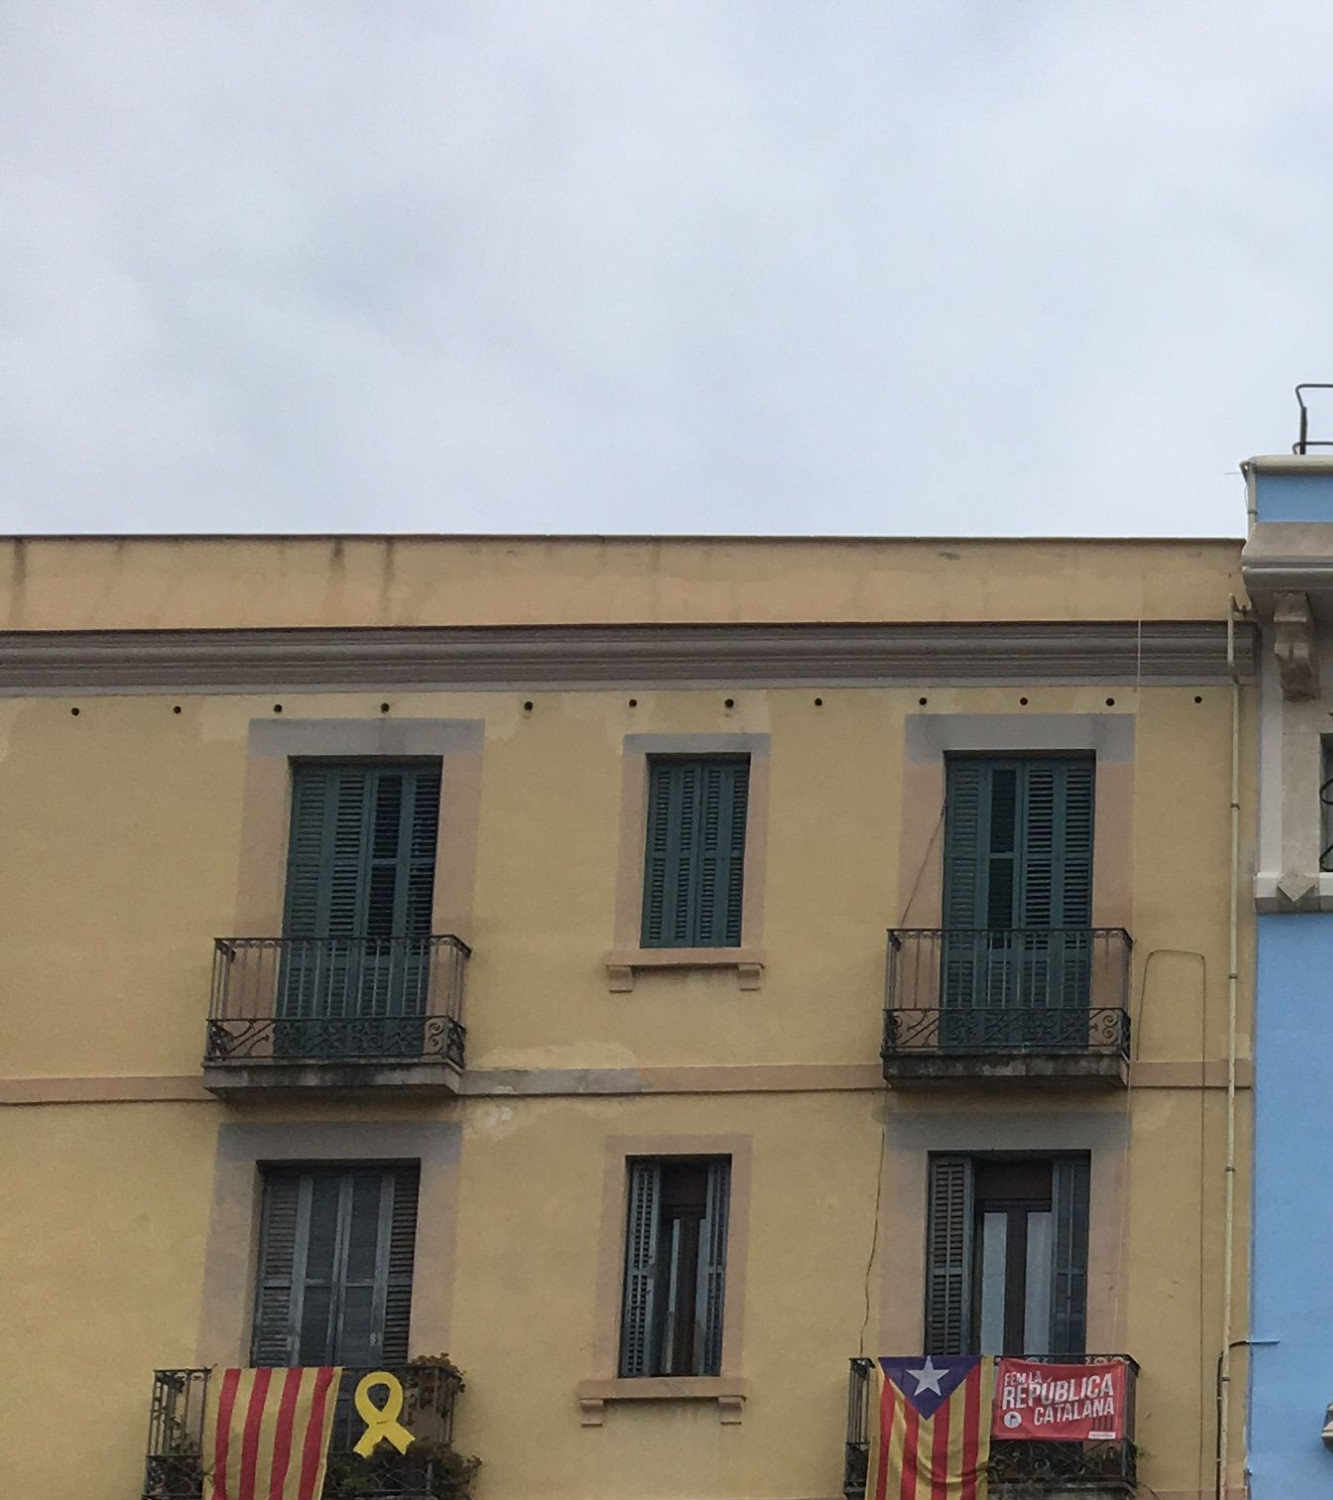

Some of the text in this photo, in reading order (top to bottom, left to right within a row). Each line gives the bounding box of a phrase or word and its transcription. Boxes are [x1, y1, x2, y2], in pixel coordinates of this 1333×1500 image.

[1002, 1373, 1114, 1410] REPÚBLICA
[1004, 1370, 1043, 1387] FEM LA
[1034, 1397, 1115, 1426] CATALANA
